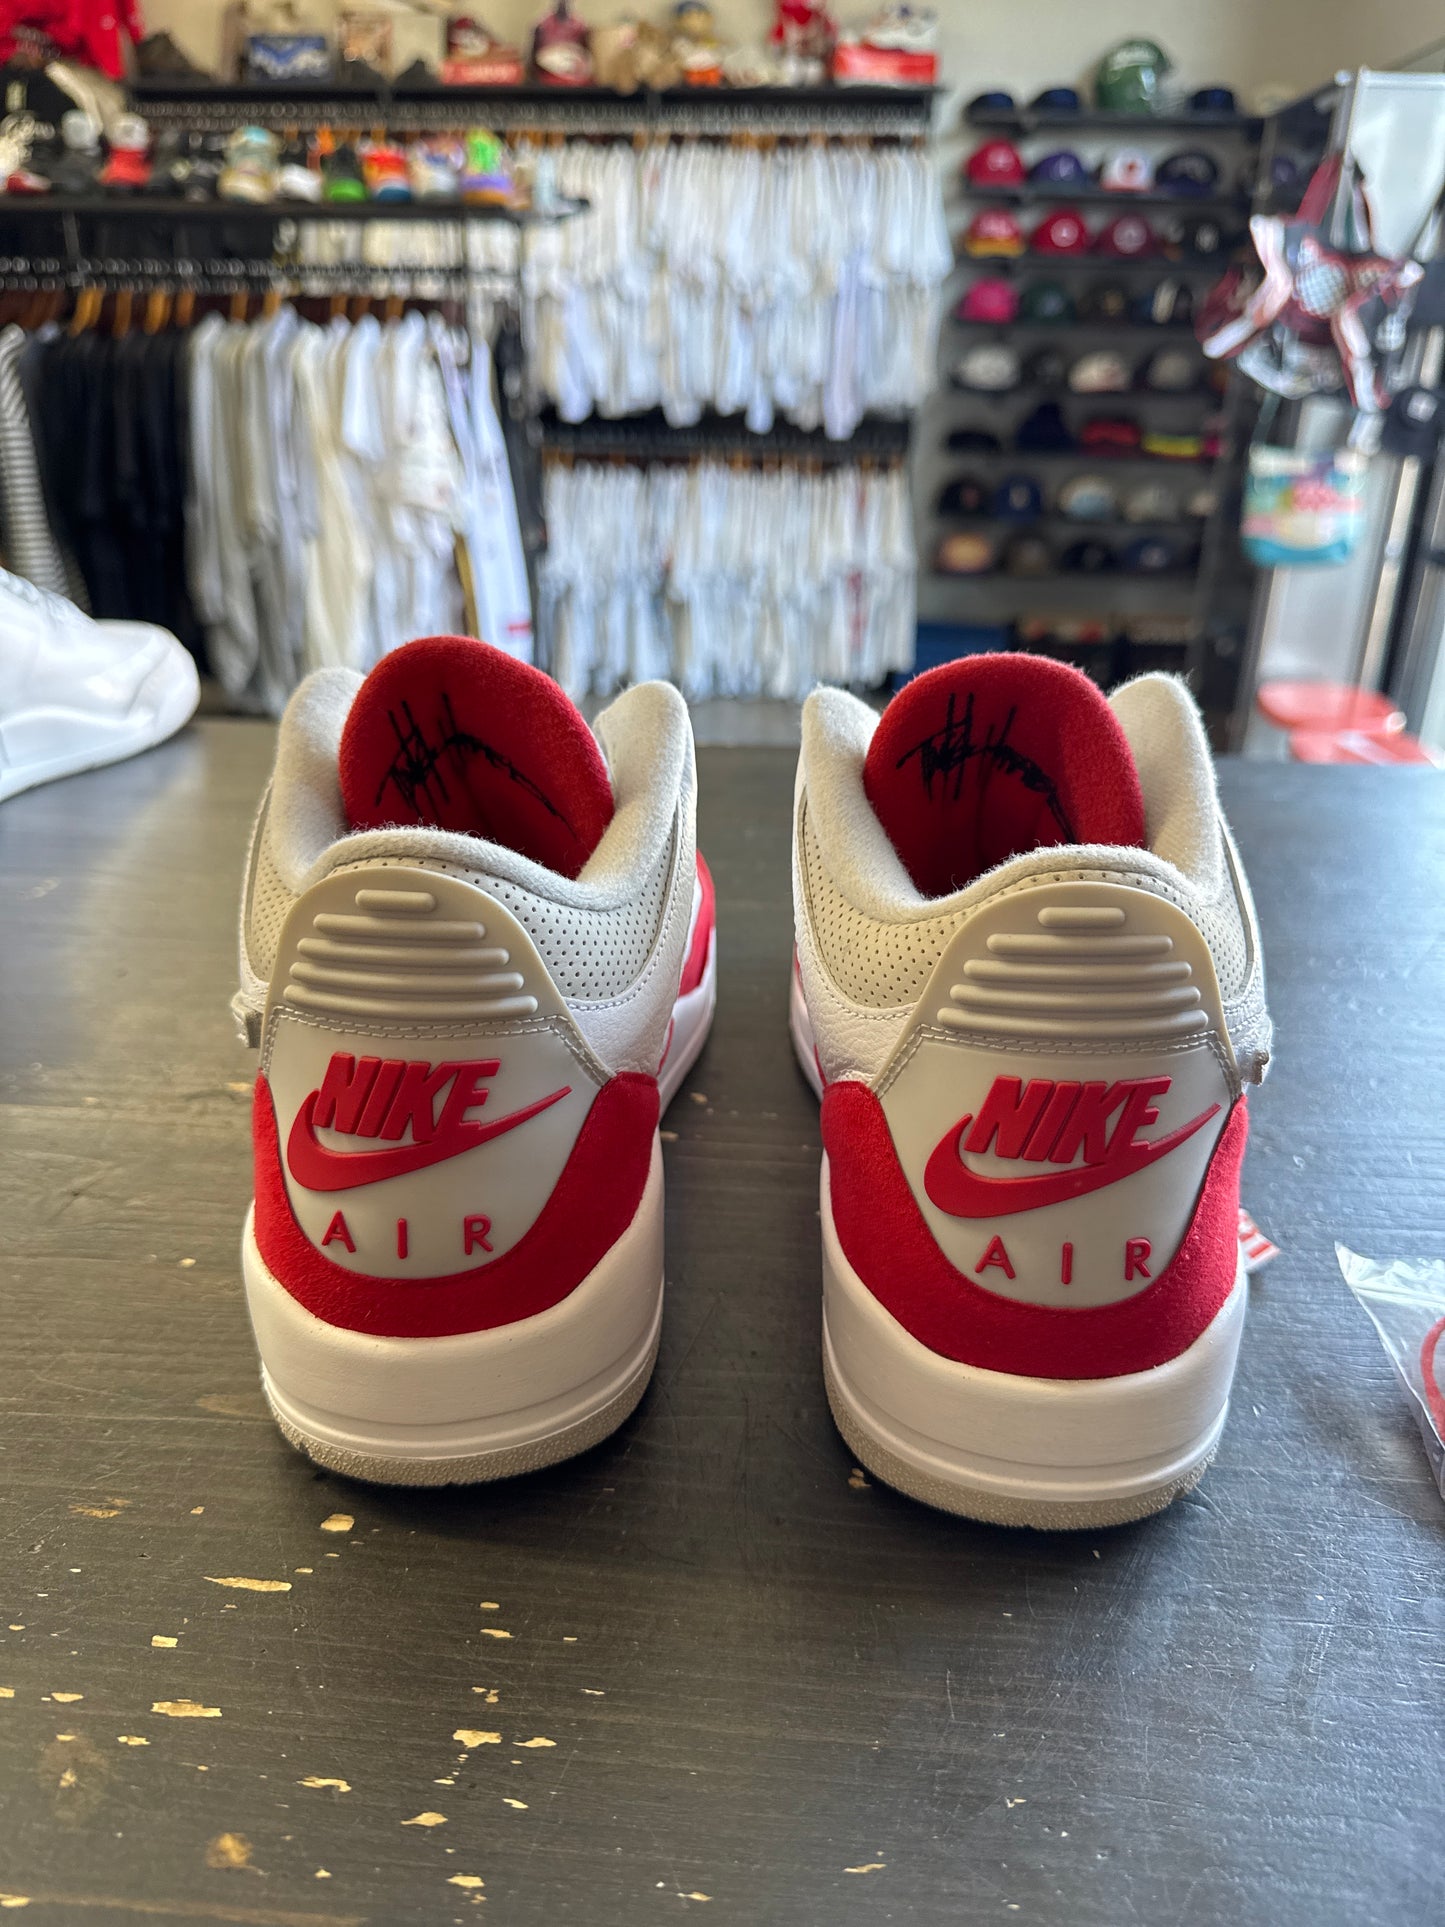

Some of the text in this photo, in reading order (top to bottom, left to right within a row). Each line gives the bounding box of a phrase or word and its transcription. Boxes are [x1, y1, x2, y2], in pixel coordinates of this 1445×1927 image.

[312, 1051, 501, 1143] NIKE
[963, 1074, 1173, 1165] NIKE
[321, 1210, 494, 1260] AIR
[974, 1235, 1152, 1285] AIR
